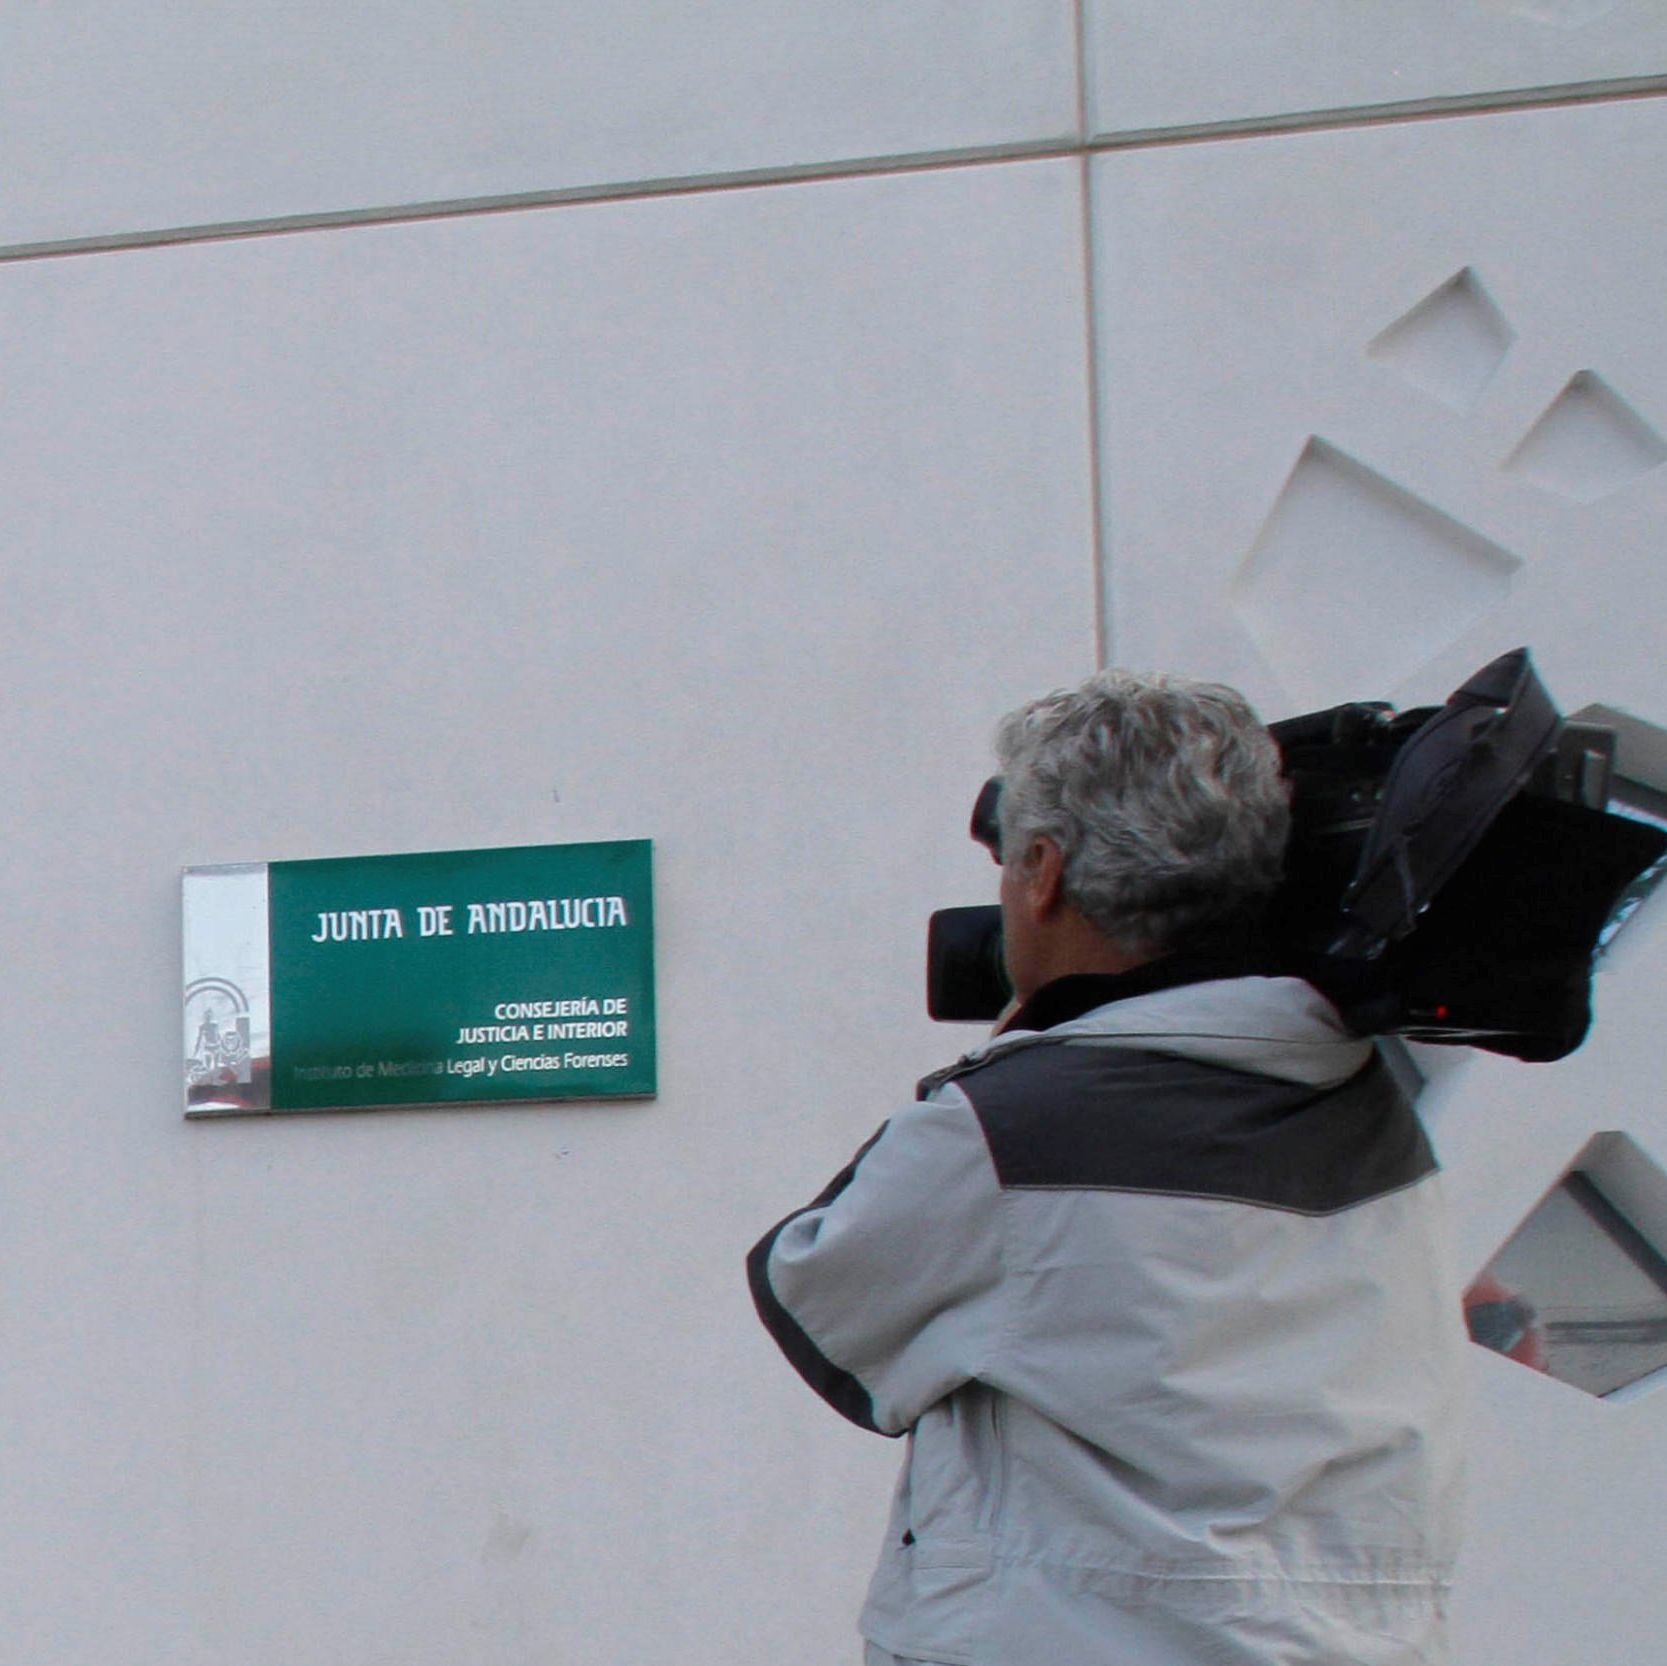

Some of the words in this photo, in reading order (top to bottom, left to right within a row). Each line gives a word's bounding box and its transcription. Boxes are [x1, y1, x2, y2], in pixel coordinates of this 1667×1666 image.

[311, 908, 403, 942] JUNTA
[417, 905, 453, 937] DE
[467, 896, 627, 934] ANDALUCIA
[495, 997, 599, 1020] CONSEJERÍA
[603, 998, 627, 1015] DE
[456, 1025, 529, 1044] JUSTICIA
[533, 1023, 544, 1041] E
[548, 1021, 627, 1039] INTERIOR
[356, 1062, 374, 1078] de
[447, 1057, 485, 1077] Legal
[487, 1060, 498, 1077] y
[501, 1054, 560, 1072] Ciencias
[564, 1052, 628, 1069] Forenses
